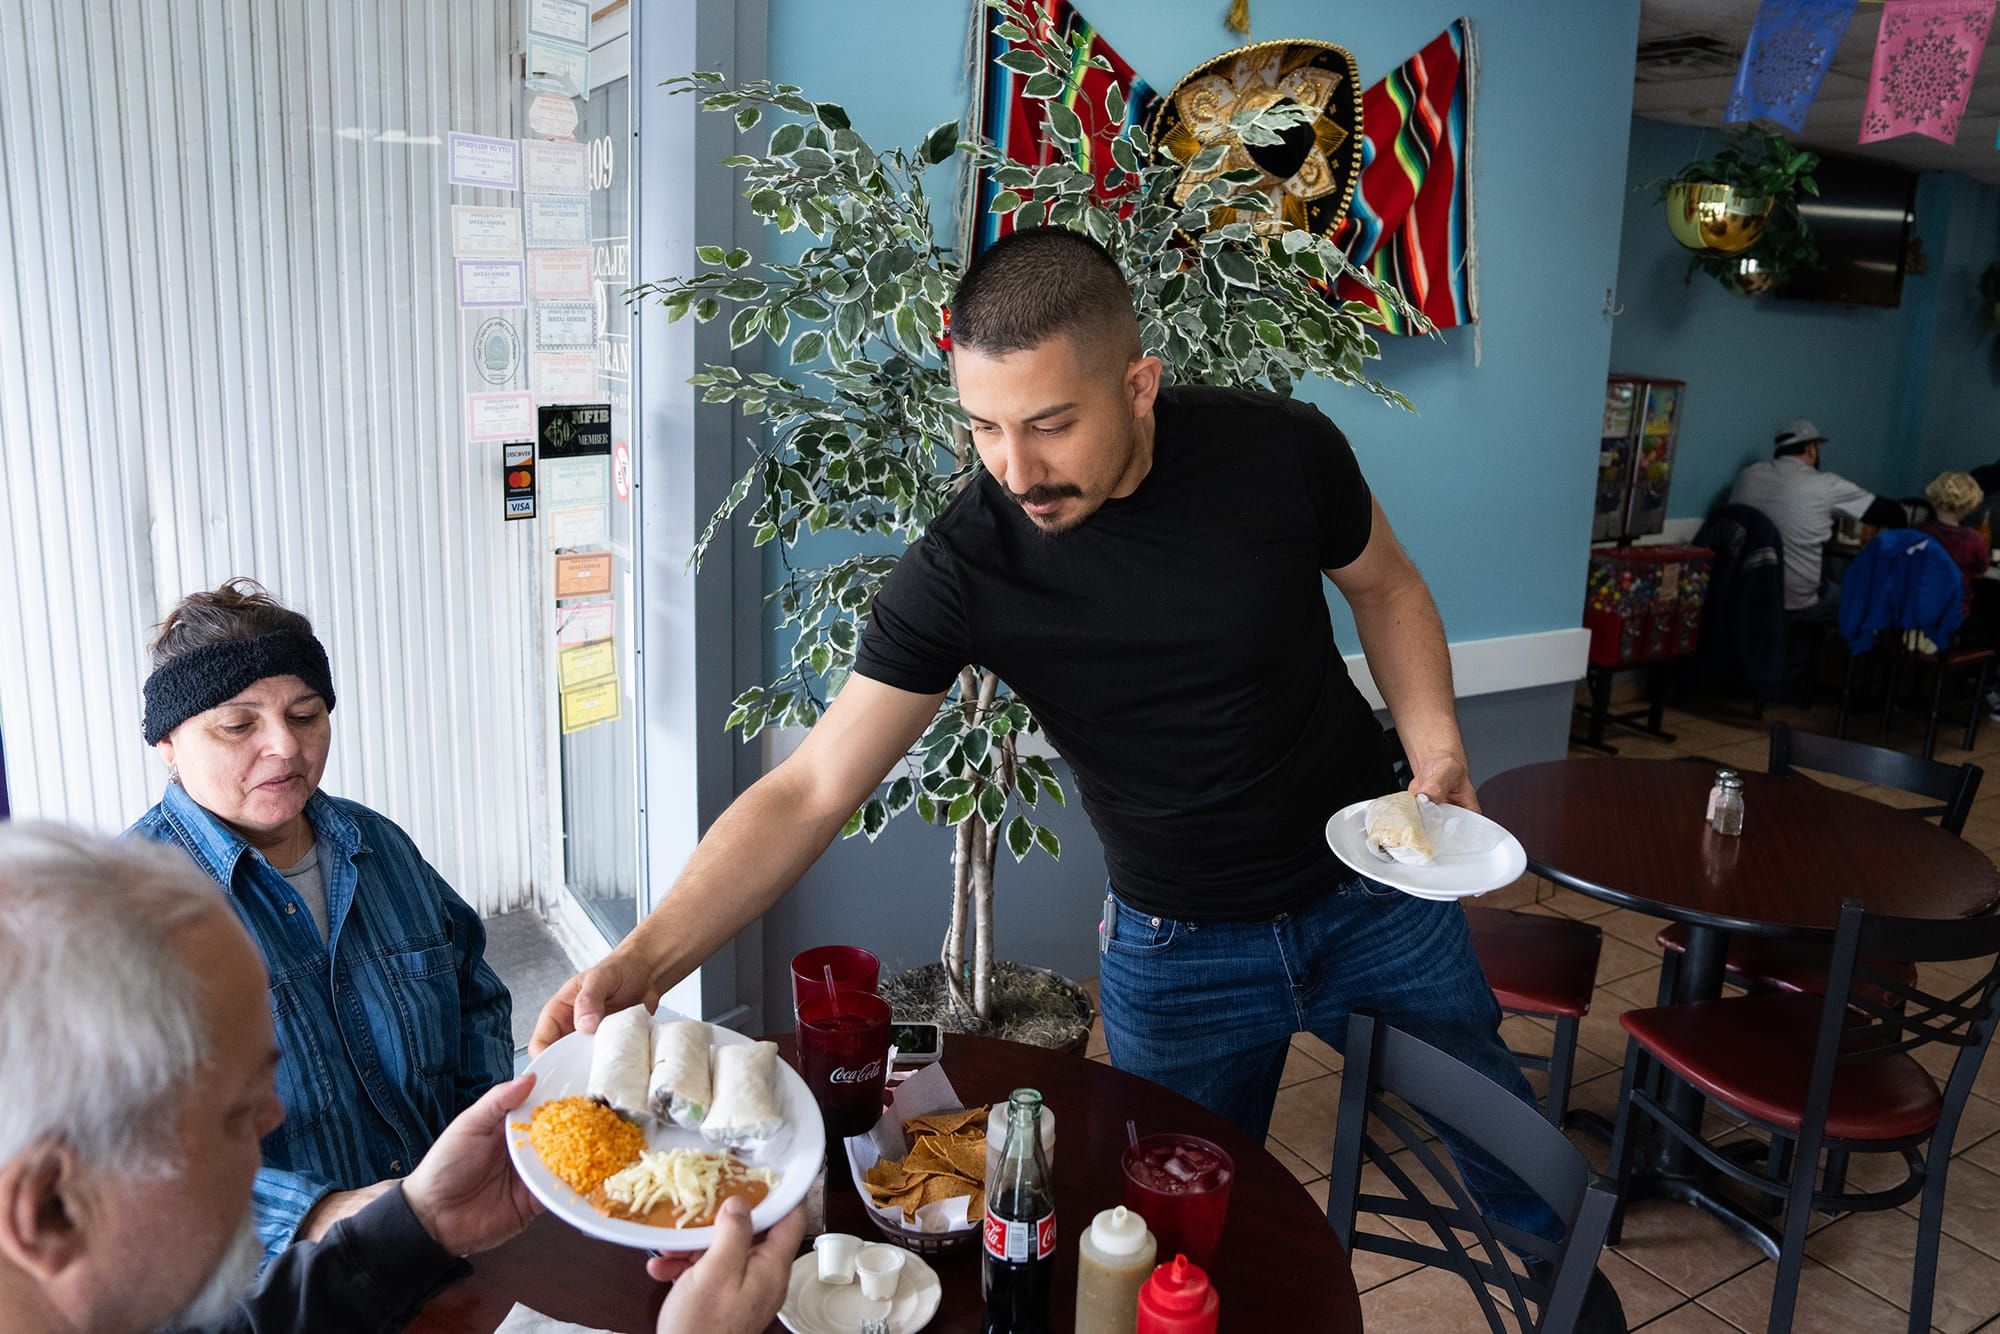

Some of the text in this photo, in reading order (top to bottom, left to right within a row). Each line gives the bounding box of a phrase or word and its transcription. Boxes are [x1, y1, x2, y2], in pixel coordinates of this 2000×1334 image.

[571, 410, 609, 424] NFIB
[578, 433, 609, 446] MEMBER
[506, 450, 531, 458] DISCOVER
[511, 502, 530, 511] VISA
